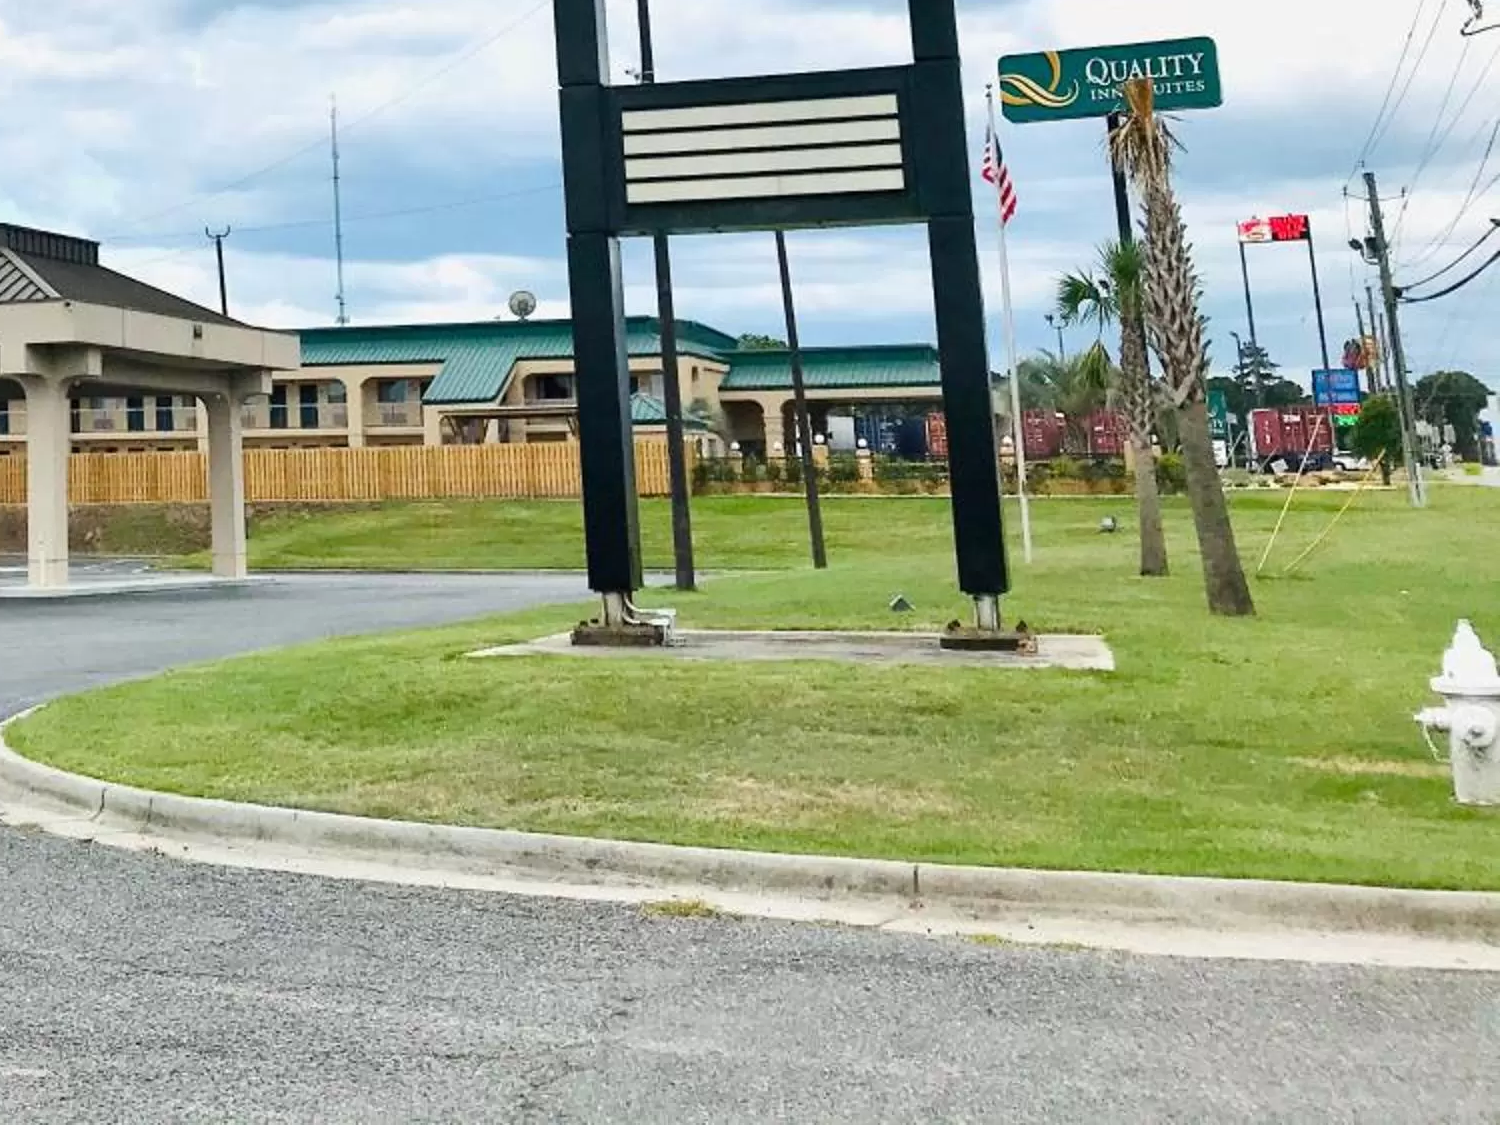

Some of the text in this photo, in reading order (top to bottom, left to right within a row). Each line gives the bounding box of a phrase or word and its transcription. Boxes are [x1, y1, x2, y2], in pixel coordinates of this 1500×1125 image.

[1085, 53, 1205, 86] QUALITY
[1091, 80, 1205, 100] INN UITES
